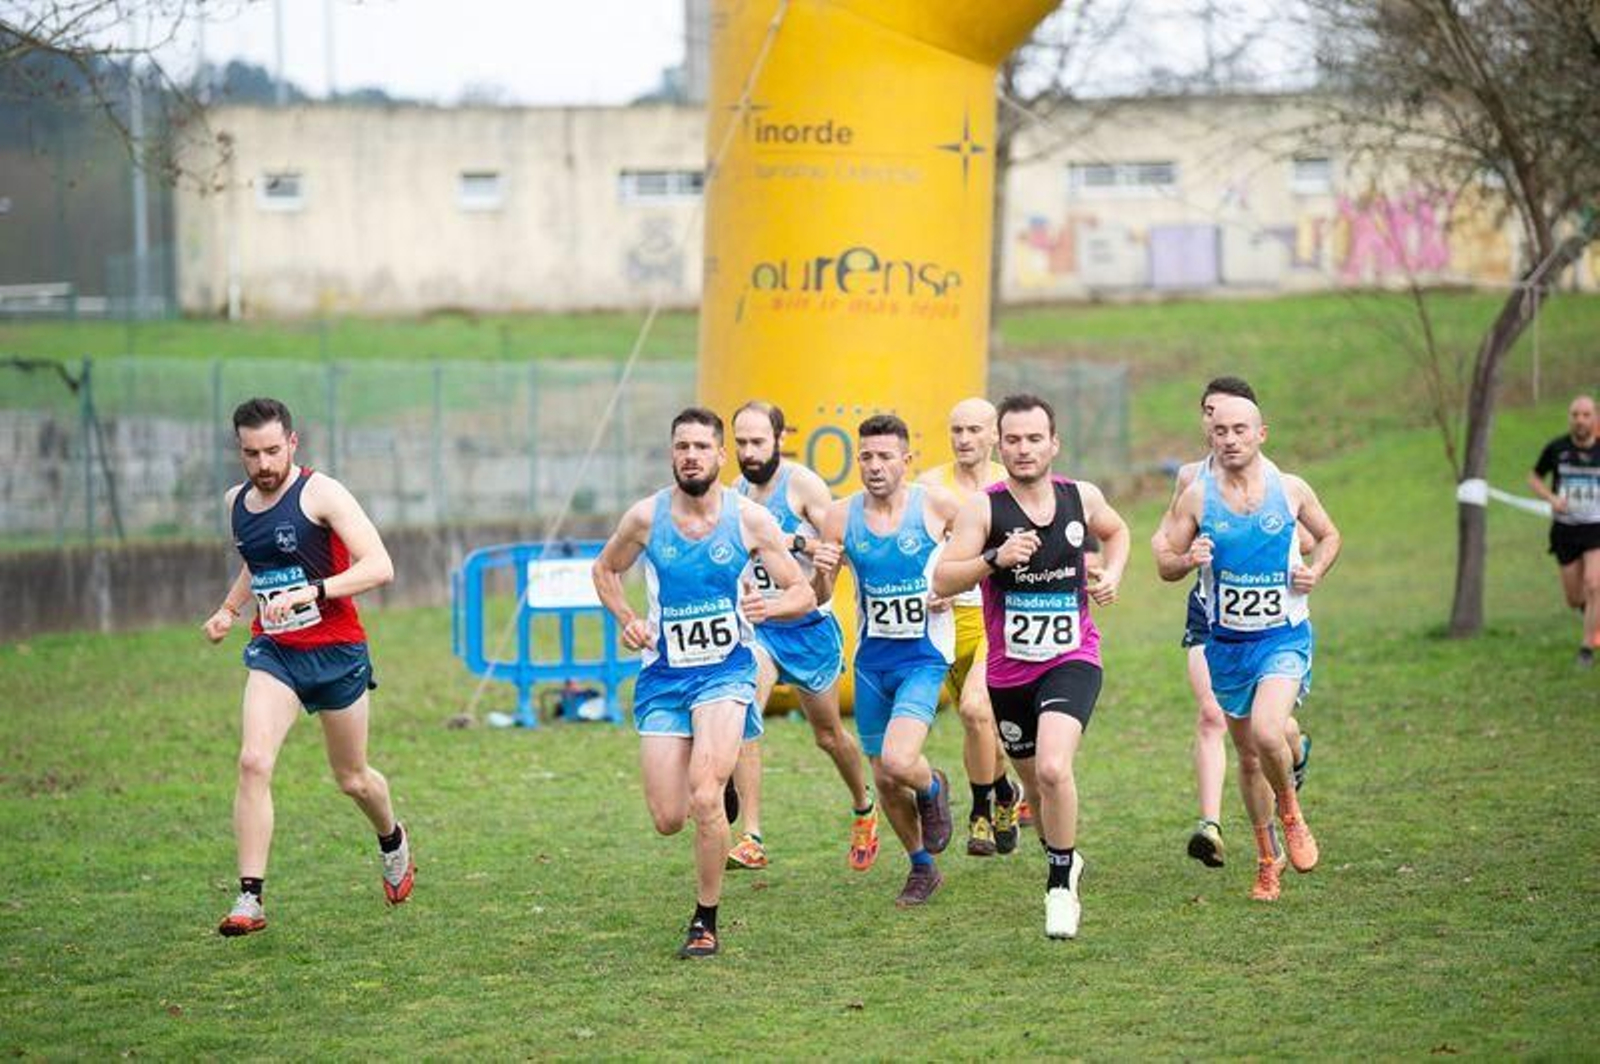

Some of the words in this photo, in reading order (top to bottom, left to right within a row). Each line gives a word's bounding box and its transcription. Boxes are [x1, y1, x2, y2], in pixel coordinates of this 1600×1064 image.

[755, 119, 853, 145] inorde
[871, 596, 924, 625] 218
[1005, 595, 1062, 609] Ribadavia
[1225, 588, 1282, 617] 223
[671, 617, 733, 653] 146
[1011, 613, 1074, 646] 278
